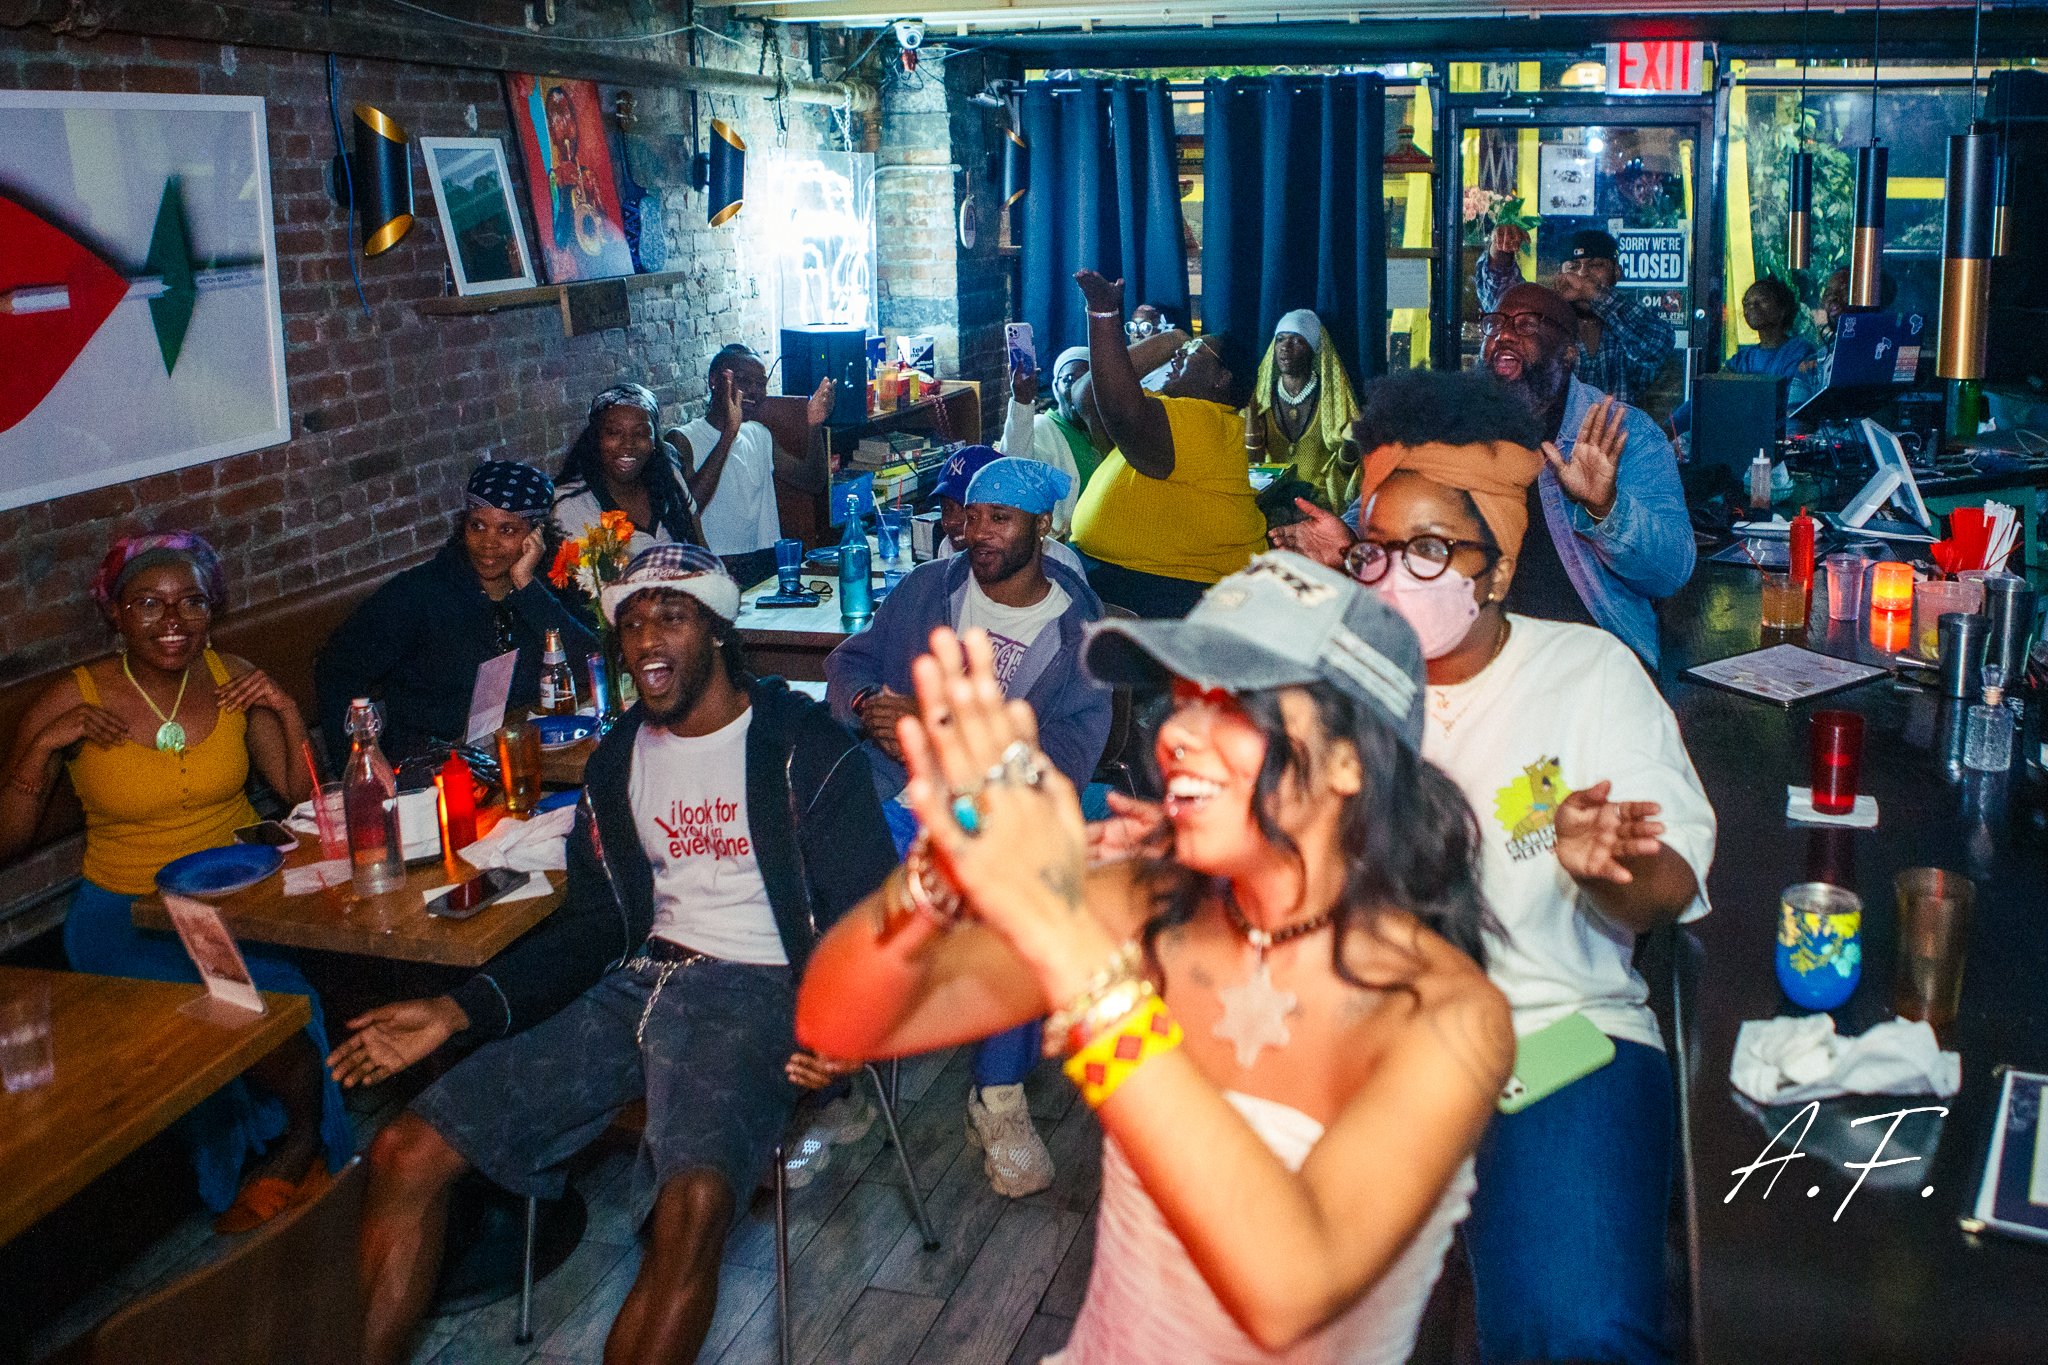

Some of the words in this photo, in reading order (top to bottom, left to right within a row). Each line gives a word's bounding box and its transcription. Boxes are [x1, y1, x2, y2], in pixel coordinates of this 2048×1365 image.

[1618, 40, 1695, 90] EXIT
[1619, 236, 1650, 251] SORRY
[1652, 236, 1681, 251] WE'RE
[1618, 253, 1680, 279] CLOSED
[912, 346, 924, 354] tell
[947, 457, 966, 476] NY
[679, 799, 713, 825] look
[715, 797, 738, 822] for
[669, 836, 749, 860] everyone
